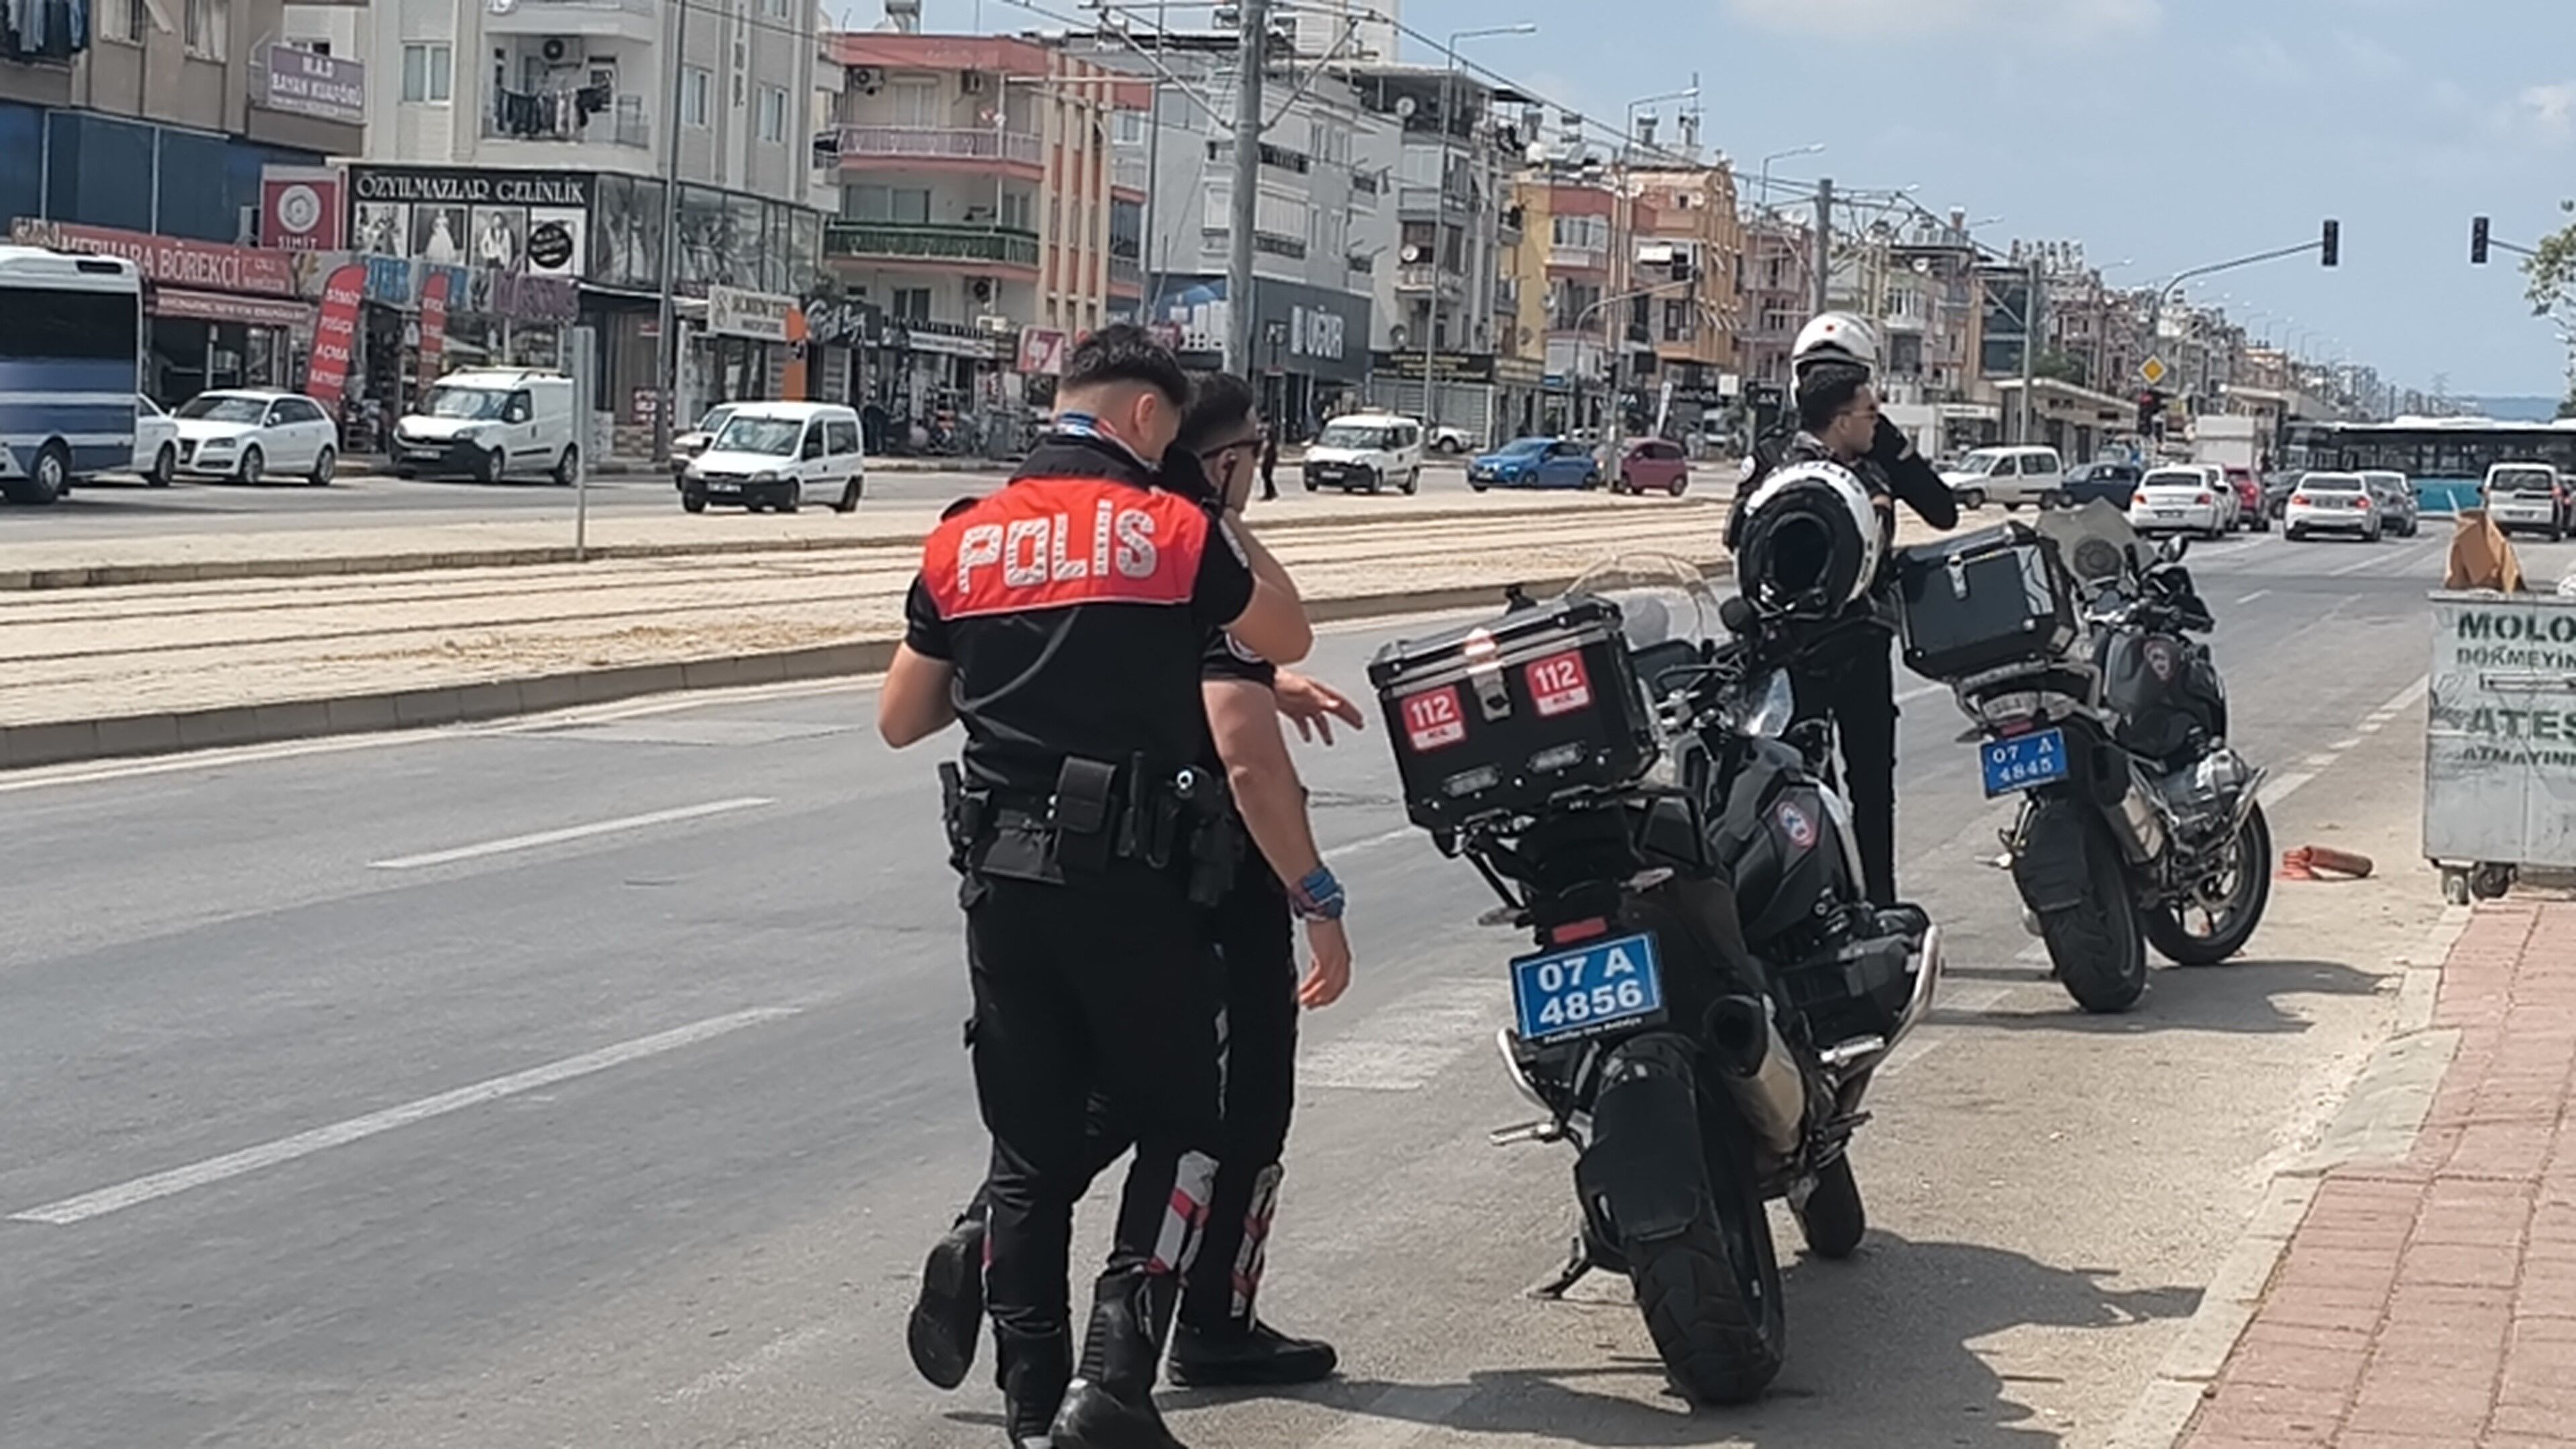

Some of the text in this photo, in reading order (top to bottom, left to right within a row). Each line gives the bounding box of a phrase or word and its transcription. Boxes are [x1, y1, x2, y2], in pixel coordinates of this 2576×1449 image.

[356, 171, 585, 204] ÖZYILMAZLAR GELİNLİK
[160, 240, 240, 288] BÖREKÇİ
[957, 498, 1158, 594] POLİS
[1535, 661, 1578, 692] 112
[1411, 696, 1454, 727] 112
[1992, 737, 2053, 763] 07 A
[1999, 757, 2053, 782] 4845
[1538, 947, 1635, 992] 07 A
[1540, 979, 1644, 1026] 4856
